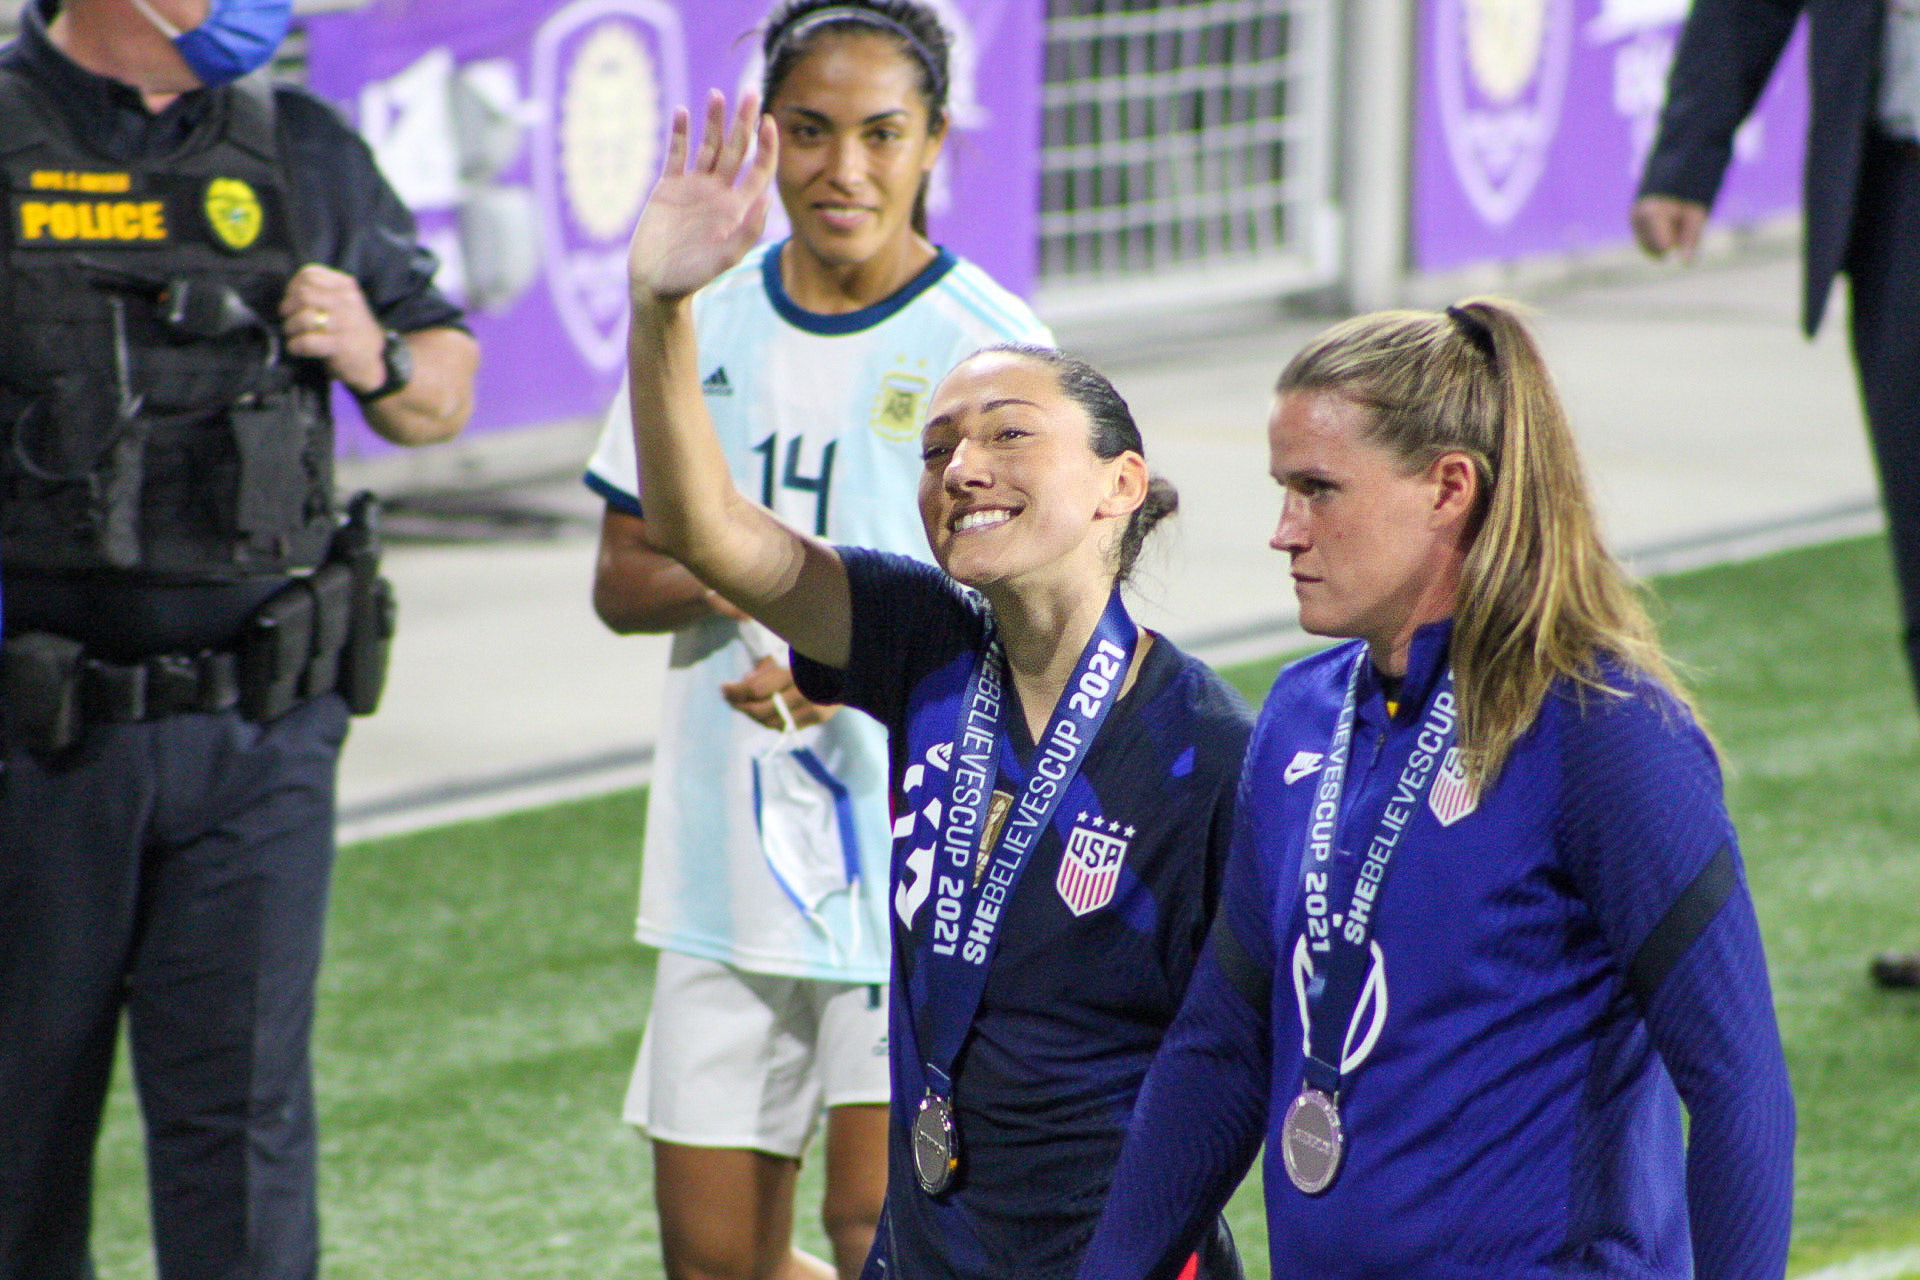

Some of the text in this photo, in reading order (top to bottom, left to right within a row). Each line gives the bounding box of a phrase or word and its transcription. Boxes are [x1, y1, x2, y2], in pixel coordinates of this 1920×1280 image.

[21, 202, 167, 240] POLICE
[751, 431, 838, 538] 14
[962, 639, 1126, 965] SHEBELIEVESCUP 2021
[1344, 691, 1458, 945] SHEBELIEVESCUP
[1071, 833, 1122, 869] USA
[933, 875, 964, 956] 2021
[1305, 872, 1331, 952] 2021
